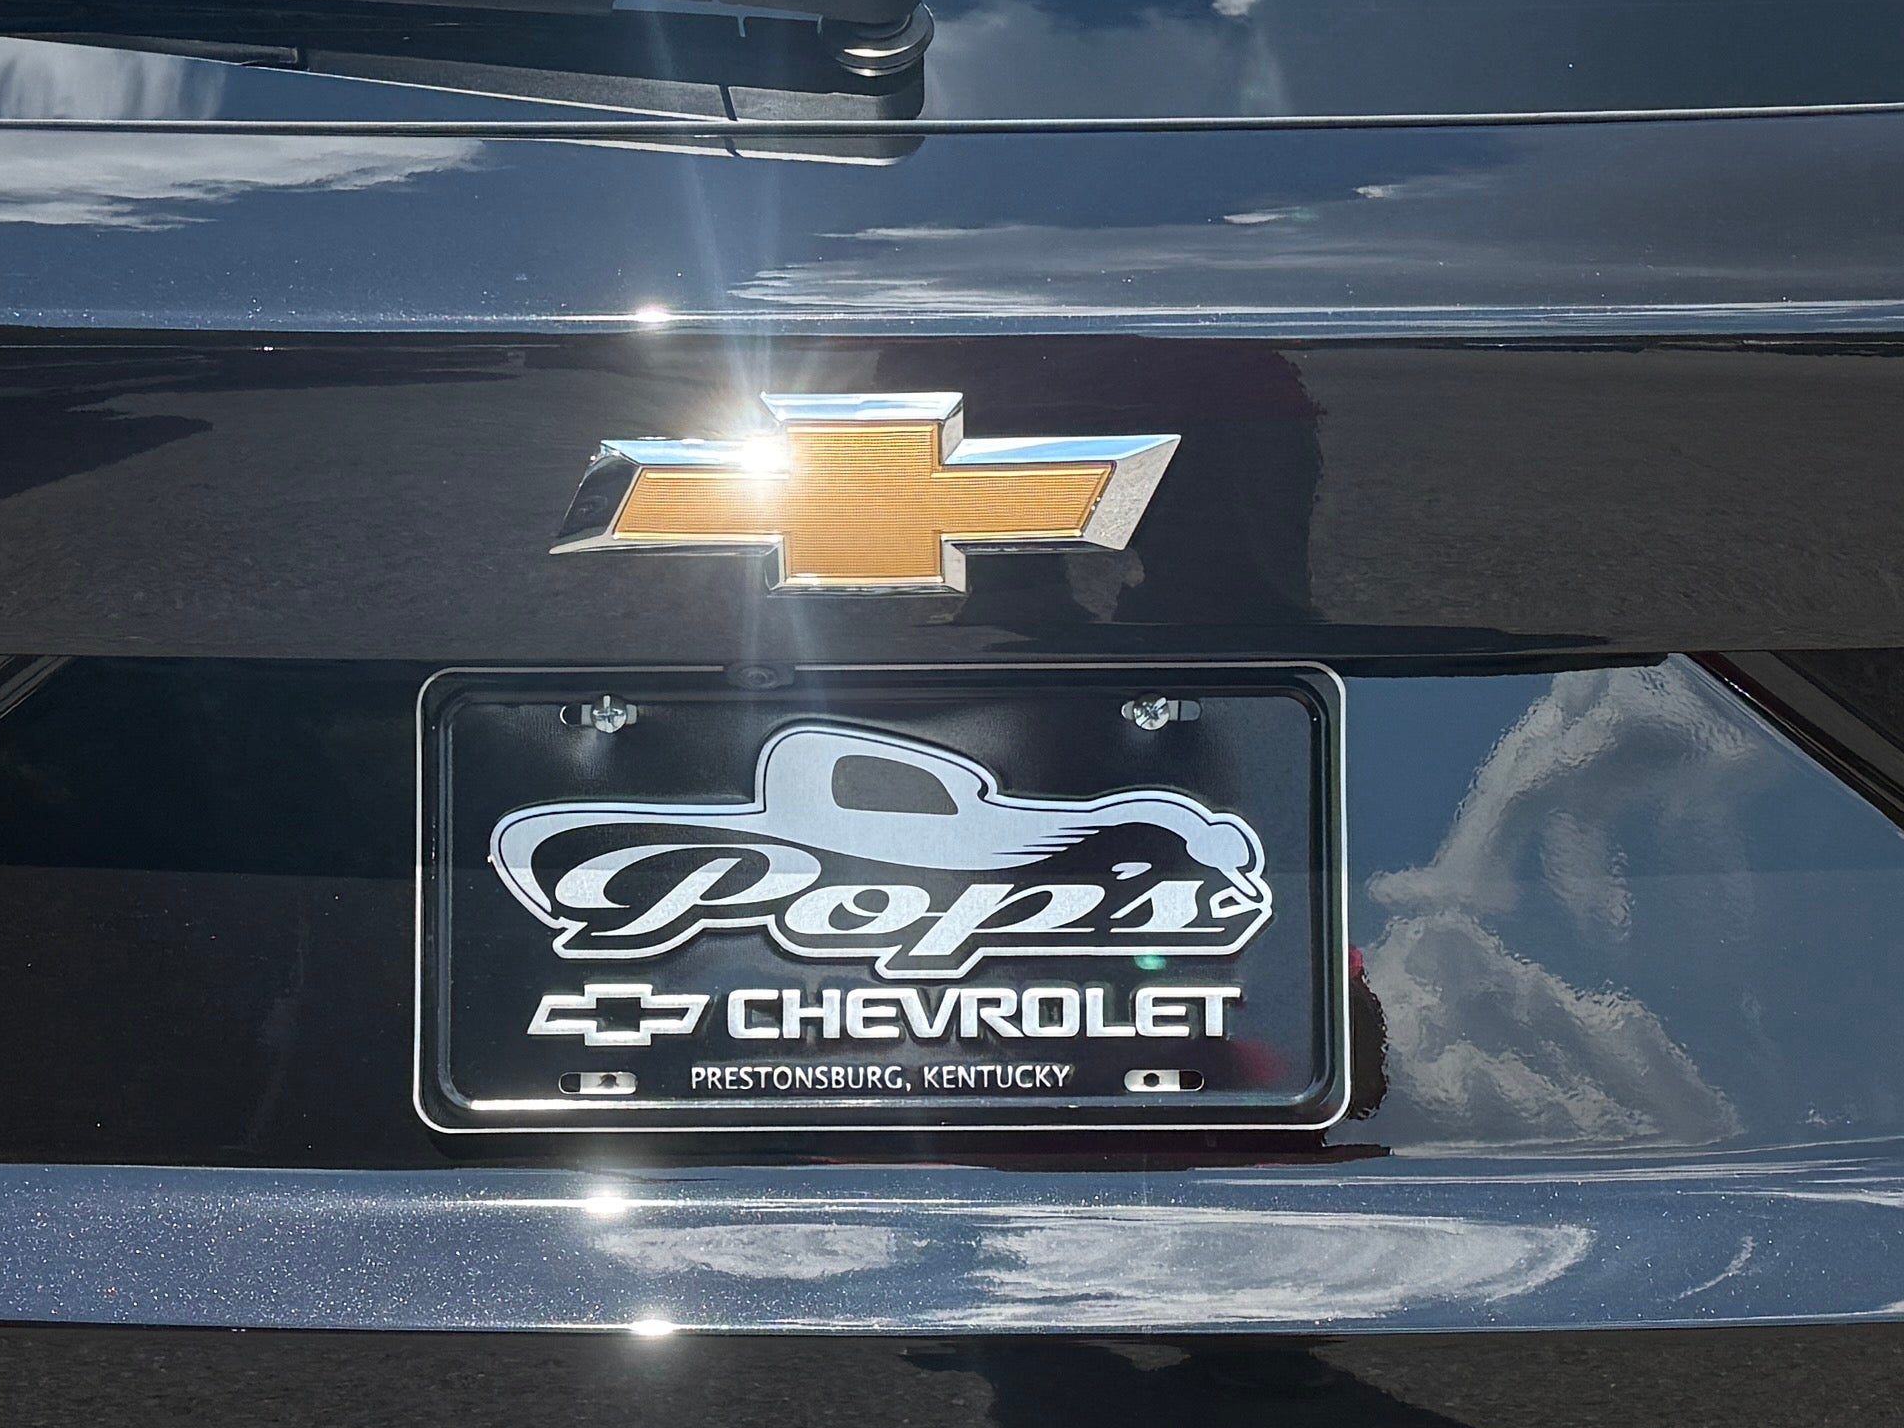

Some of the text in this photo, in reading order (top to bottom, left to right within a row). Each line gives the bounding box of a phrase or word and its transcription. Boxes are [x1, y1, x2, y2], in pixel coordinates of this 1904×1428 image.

[555, 843, 1226, 956] Pop's
[727, 988, 1241, 1038] CHEVROLET
[691, 1065, 1071, 1092] PRESTONSBURG, KENTUCKY
